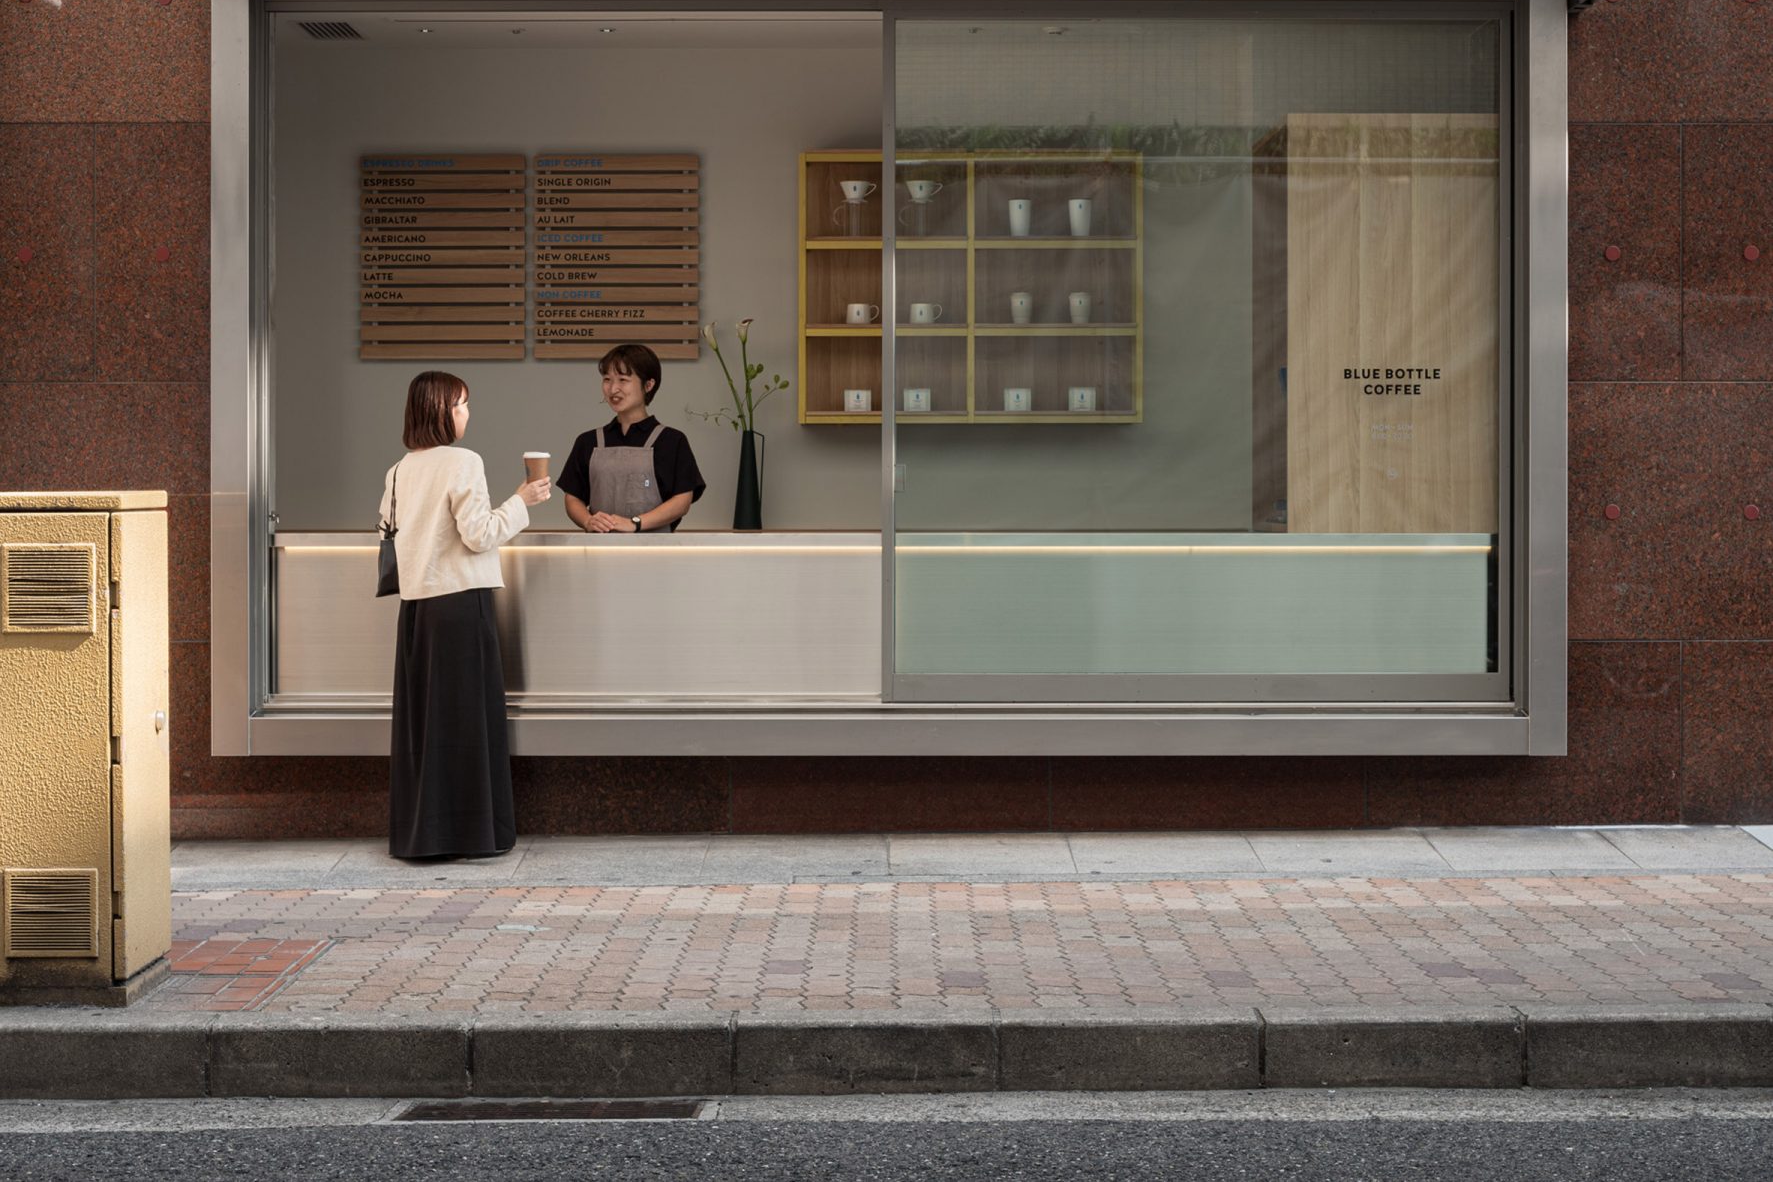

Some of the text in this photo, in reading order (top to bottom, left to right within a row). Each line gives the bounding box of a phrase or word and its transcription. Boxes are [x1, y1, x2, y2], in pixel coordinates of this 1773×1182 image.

[563, 159, 603, 167] COFFEE
[364, 179, 415, 187] ESPRESSO
[537, 178, 611, 186] SINGLE ORIGIN
[364, 197, 425, 205] MACCHIATO
[537, 197, 570, 205] BLEND
[364, 216, 417, 224] GIBRALTAR
[537, 216, 575, 224] AU LAIT
[364, 235, 426, 243] AMERICANO
[537, 234, 603, 242] ICED COFFEE
[364, 254, 431, 262] CAPPUCCINO
[537, 253, 610, 261] NEW ORLEANS
[364, 273, 393, 281] LATTE
[537, 272, 597, 280] COLD BREW
[364, 292, 403, 300] MOCHA
[537, 290, 601, 299] NON COFFEE
[537, 310, 645, 318] COFFEE CHERRY FIZZ
[537, 329, 594, 337] LEMONADE
[1343, 368, 1441, 379] BLUE BOTTLE
[1364, 384, 1421, 395] COFFEE
